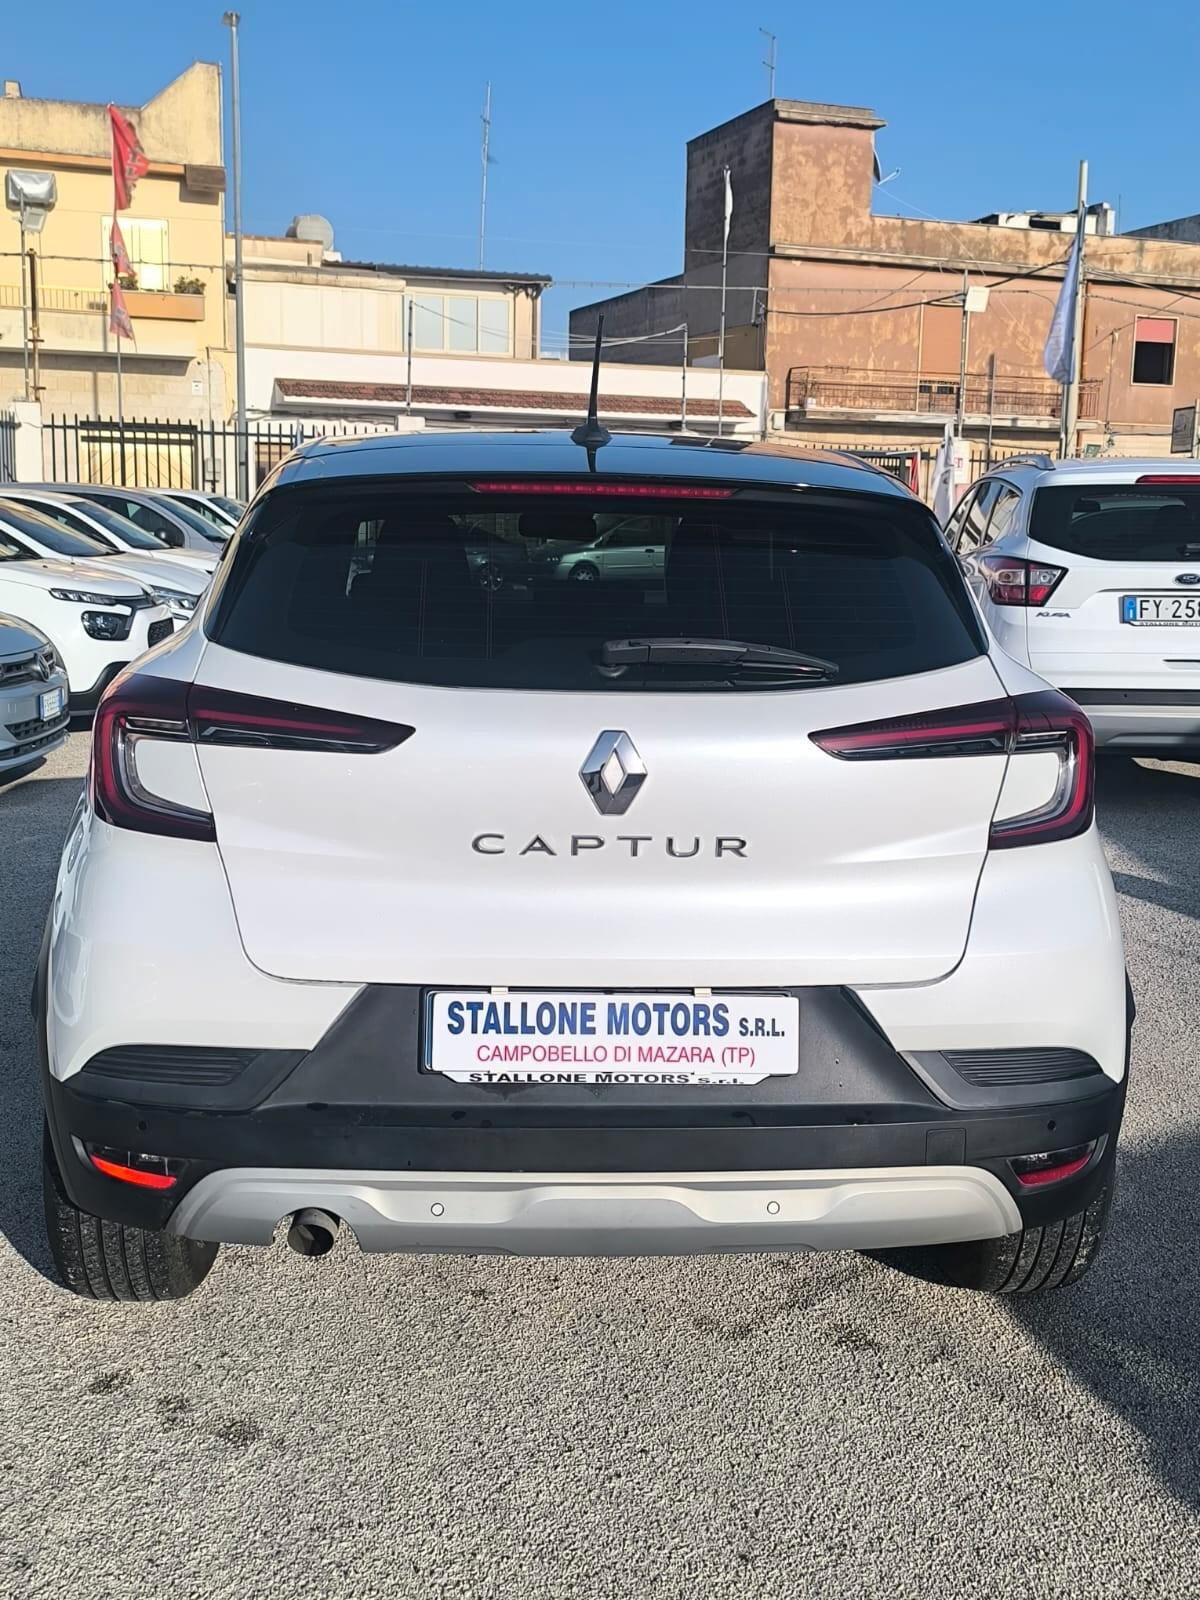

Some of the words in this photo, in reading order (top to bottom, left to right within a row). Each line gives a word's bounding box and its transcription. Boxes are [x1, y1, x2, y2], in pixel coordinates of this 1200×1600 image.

[1140, 600, 1162, 618] FY
[1172, 600, 1200, 618] 25
[471, 833, 748, 858] CAPTUR
[447, 1001, 597, 1035] STALLONE
[607, 1003, 730, 1036] MOTORS
[739, 1018, 785, 1037] S.R.L.
[477, 1045, 607, 1062] CAMPOBELLO
[613, 1045, 632, 1062] DI
[637, 1046, 716, 1063] MAZARA
[721, 1046, 756, 1067] (TP)
[468, 1073, 587, 1083] STALLONE
[595, 1073, 690, 1083] MOTORS
